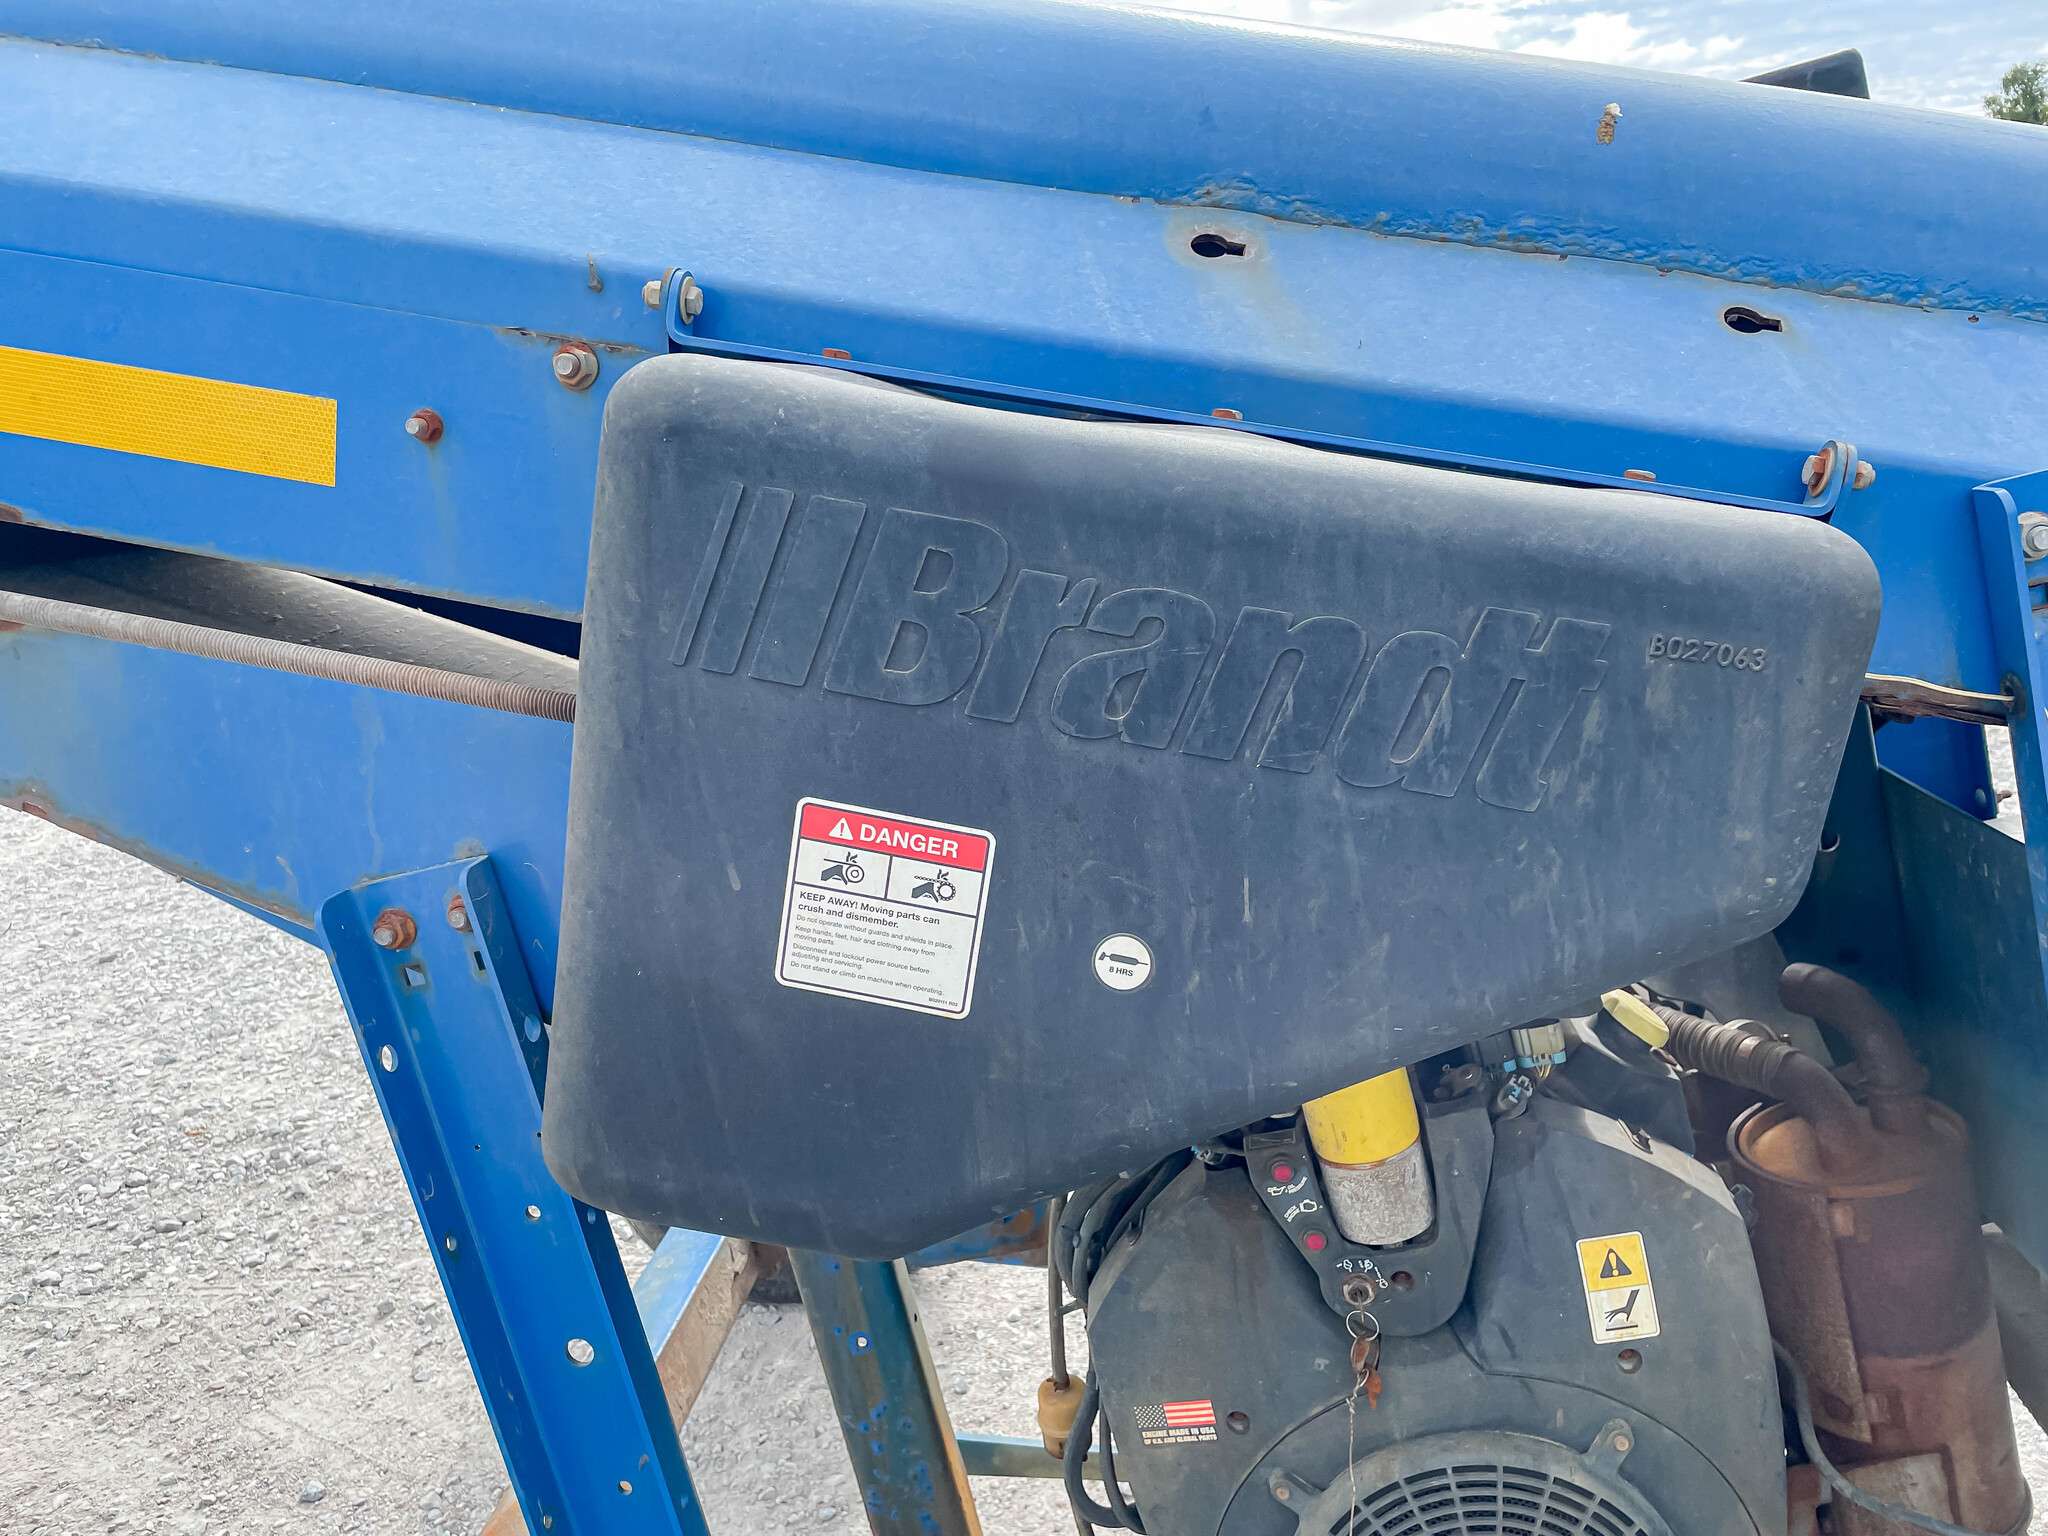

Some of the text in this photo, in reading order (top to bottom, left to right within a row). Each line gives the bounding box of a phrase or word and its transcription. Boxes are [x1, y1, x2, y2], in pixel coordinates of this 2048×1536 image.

[824, 506, 1612, 812] Brandt
[1650, 632, 1767, 672] B027063
[860, 823, 959, 858] DANGER
[798, 904, 899, 928] crush and dismember.
[800, 891, 940, 925] KEEP AWAY! Moving parts can
[794, 933, 834, 946] moving parts.
[795, 925, 811, 933] Keep
[813, 928, 833, 937] hands,
[835, 932, 848, 940] feet,
[877, 940, 901, 951] clothing
[903, 946, 919, 954] away
[819, 918, 842, 928] operate
[844, 922, 866, 932] without
[868, 929, 889, 937] guards
[905, 935, 926, 945] shields
[935, 941, 953, 950] place.
[792, 951, 819, 962] adjusting
[834, 959, 863, 969] servicing.
[793, 943, 827, 954] Disconnect
[842, 952, 864, 961] lockout
[866, 957, 885, 965] power
[887, 961, 908, 970] source
[910, 965, 929, 974] before
[1116, 968, 1133, 976] HRS
[813, 966, 829, 974] stand
[867, 976, 893, 985] machine
[913, 984, 943, 996] operating.
[1142, 1430, 1168, 1438] ENGINE
[1200, 1426, 1215, 1434] USA
